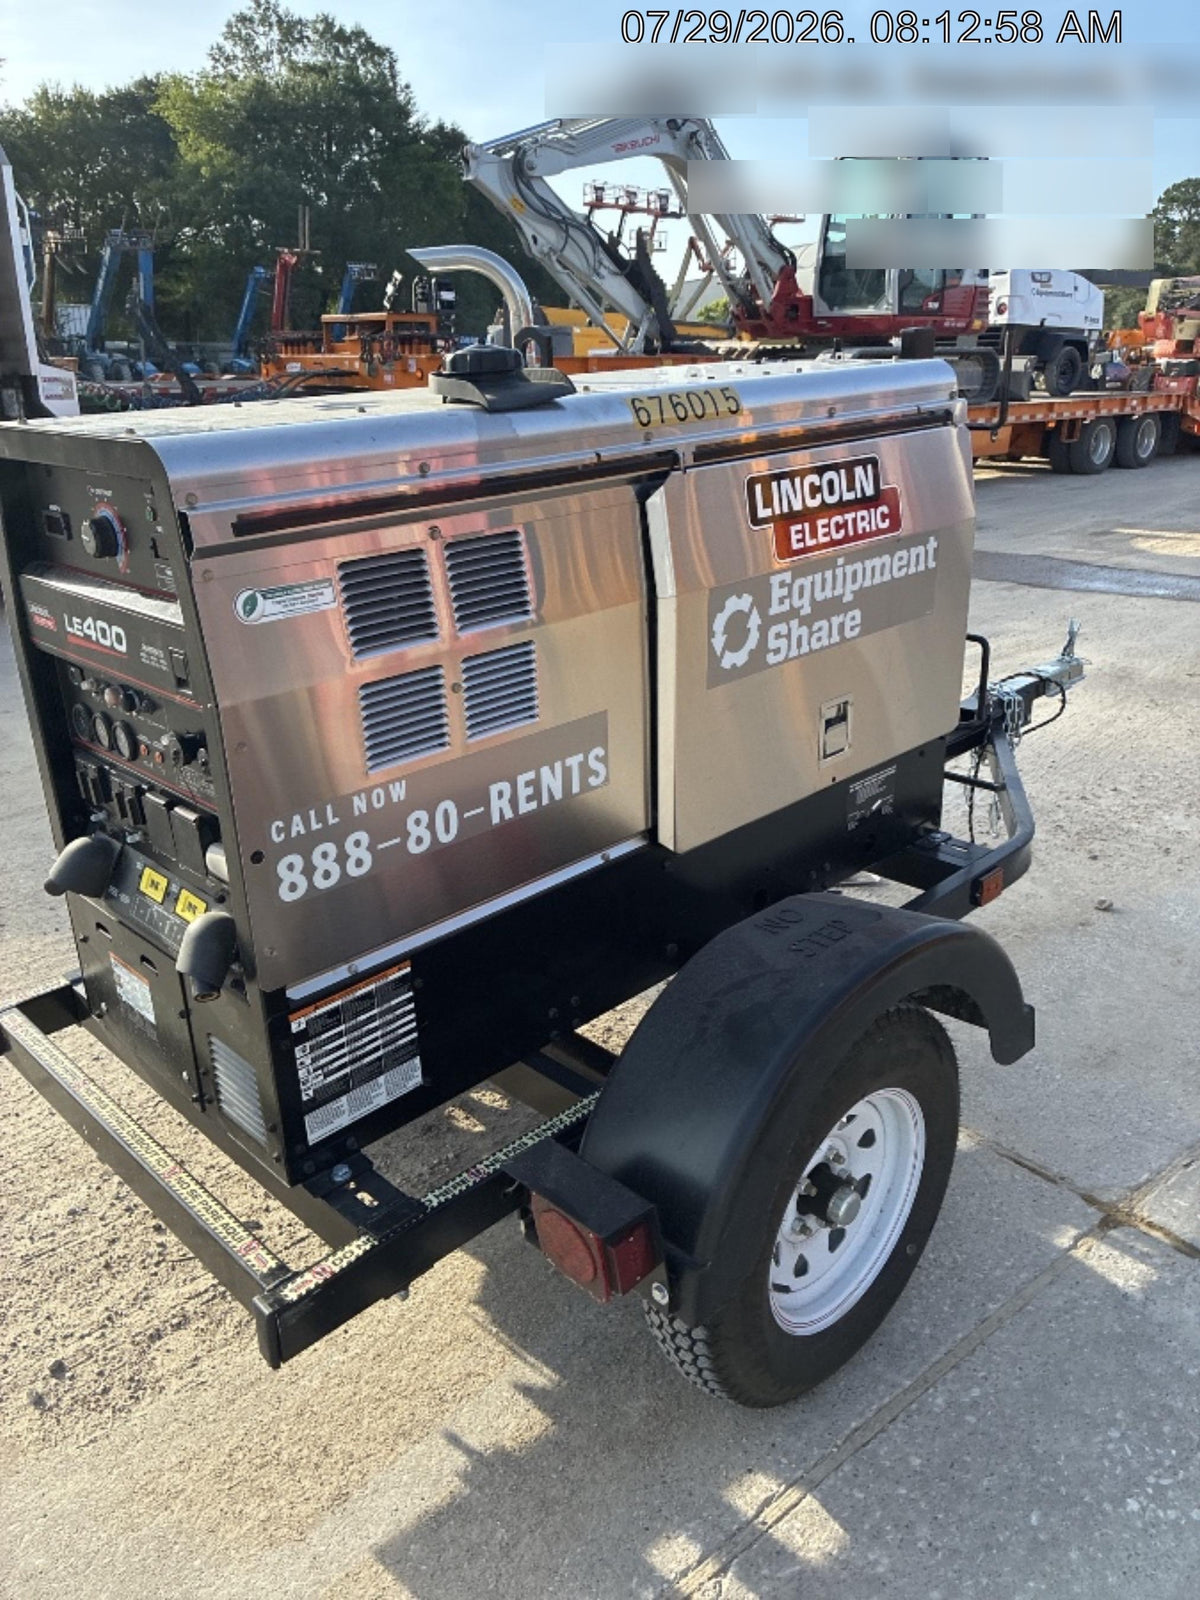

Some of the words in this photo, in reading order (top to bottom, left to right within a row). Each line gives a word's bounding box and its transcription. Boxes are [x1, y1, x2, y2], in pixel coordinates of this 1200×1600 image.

[631, 386, 740, 427] 676015
[754, 463, 876, 519] LINCOLN
[789, 504, 890, 551] ELECTRIC
[768, 536, 938, 616] Equipment
[63, 612, 127, 654] LE400
[765, 607, 862, 666] Share
[270, 803, 340, 844] CALL
[352, 780, 407, 817] NOW
[754, 908, 804, 935] NO
[787, 919, 853, 958] STEP
[200, 1201, 224, 1224] PARE
